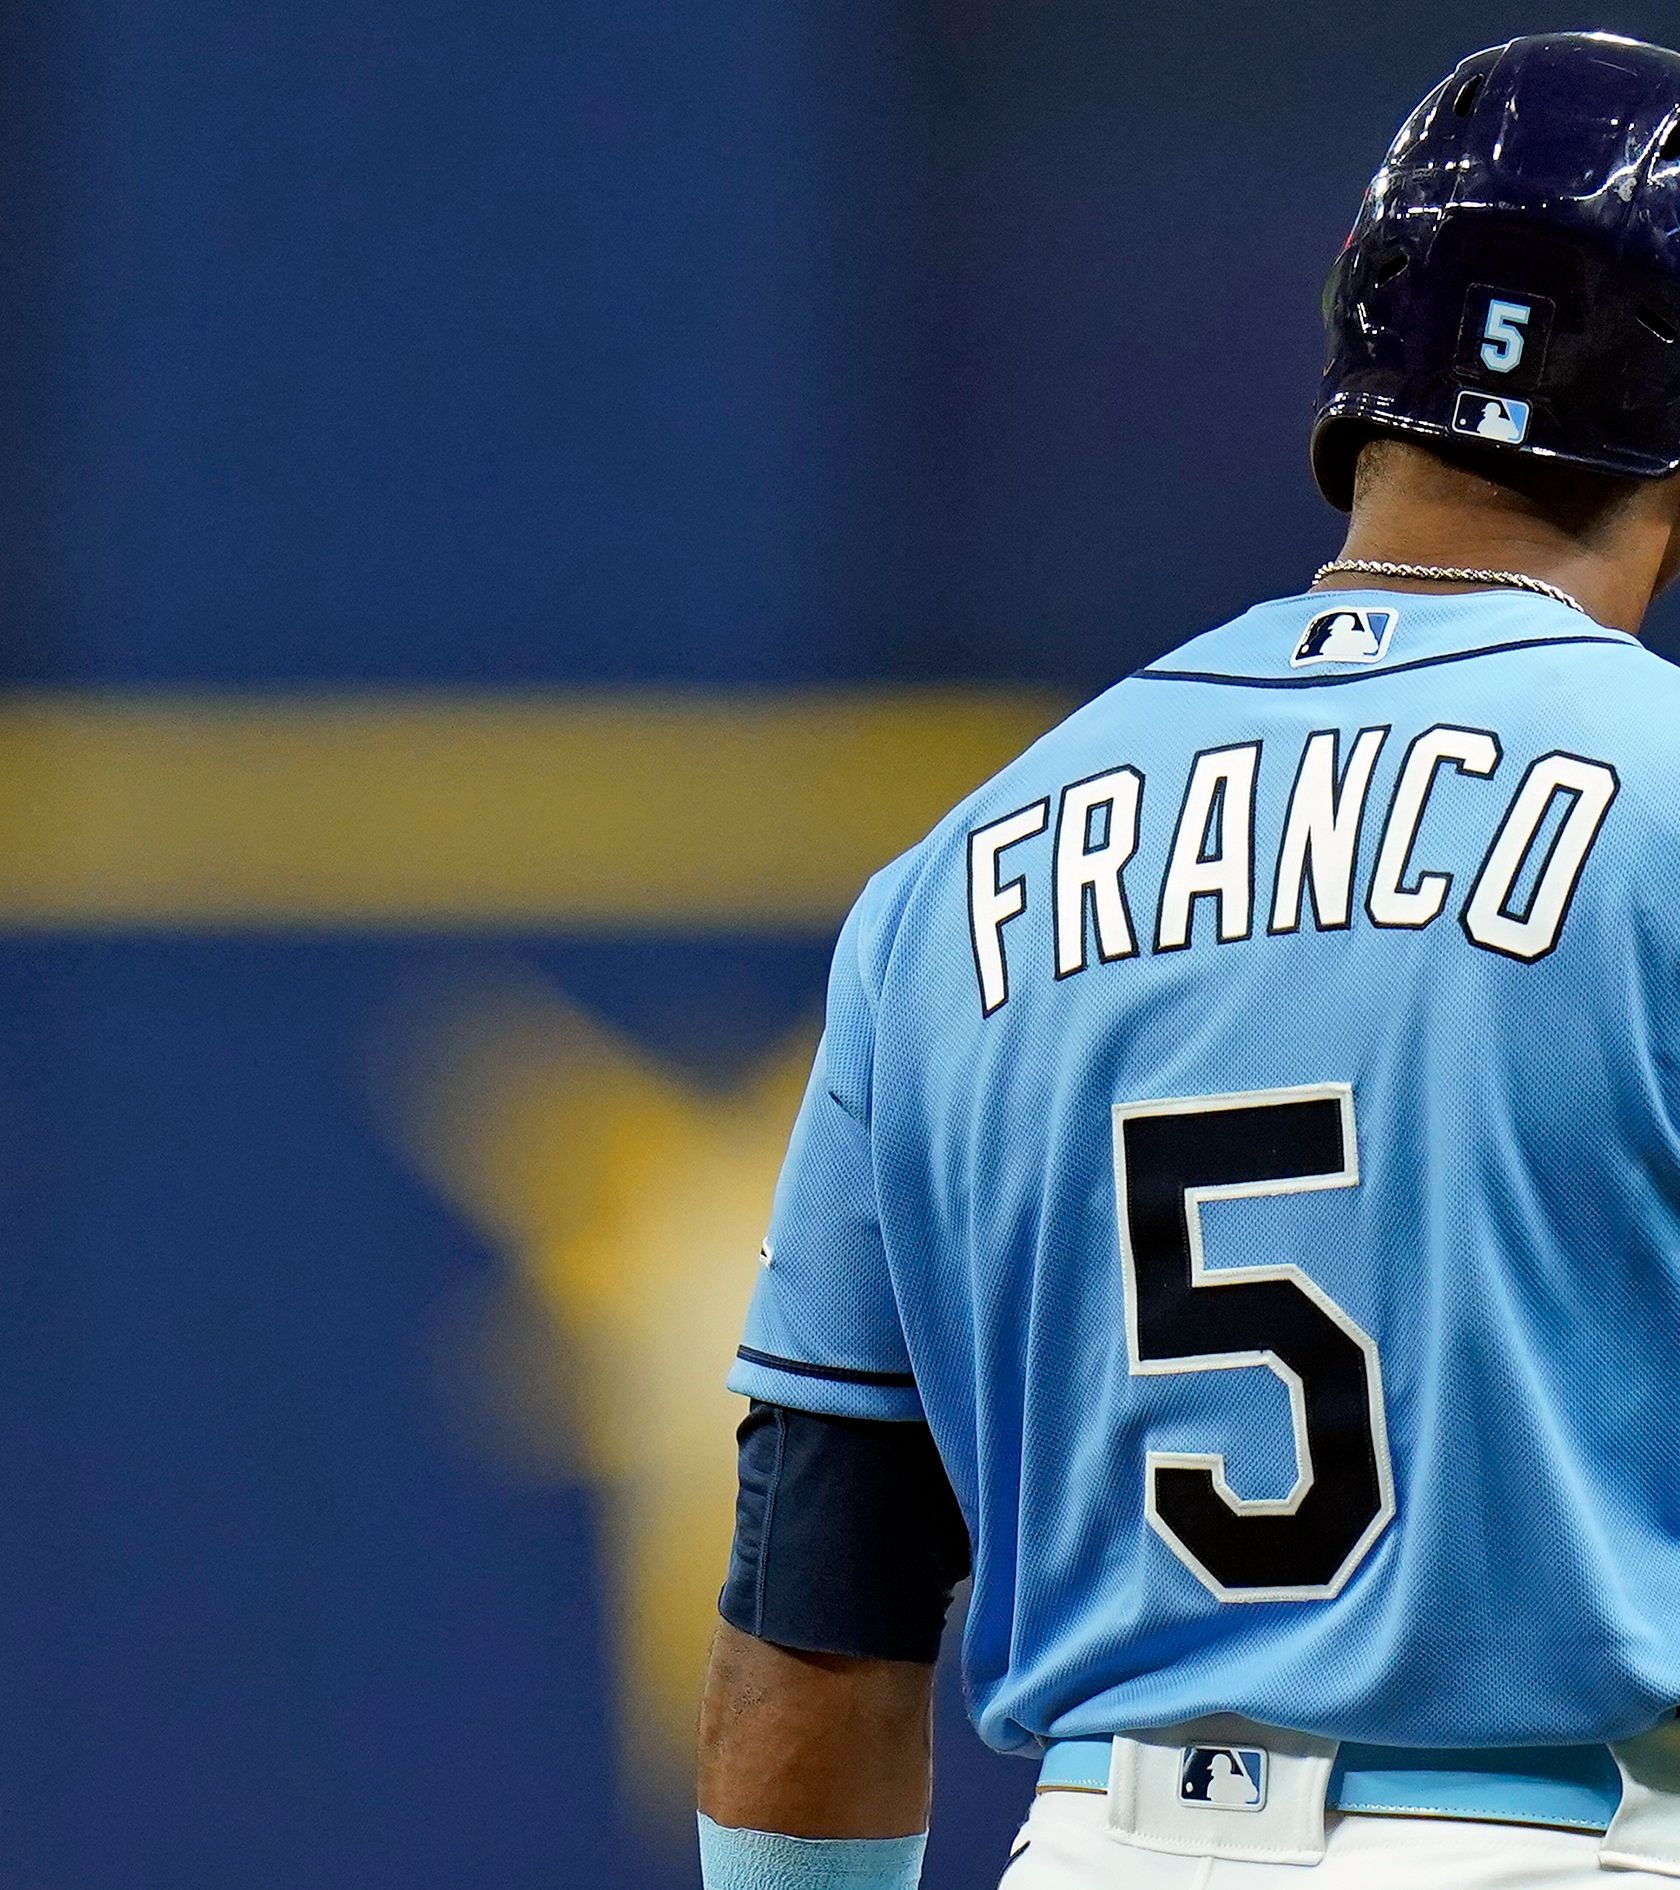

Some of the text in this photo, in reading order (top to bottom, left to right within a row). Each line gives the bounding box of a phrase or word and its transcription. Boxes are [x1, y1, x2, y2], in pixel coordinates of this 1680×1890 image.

[1480, 298, 1529, 373] 5
[967, 723, 1621, 1018] FRANCO
[1112, 1081, 1396, 1603] 5
